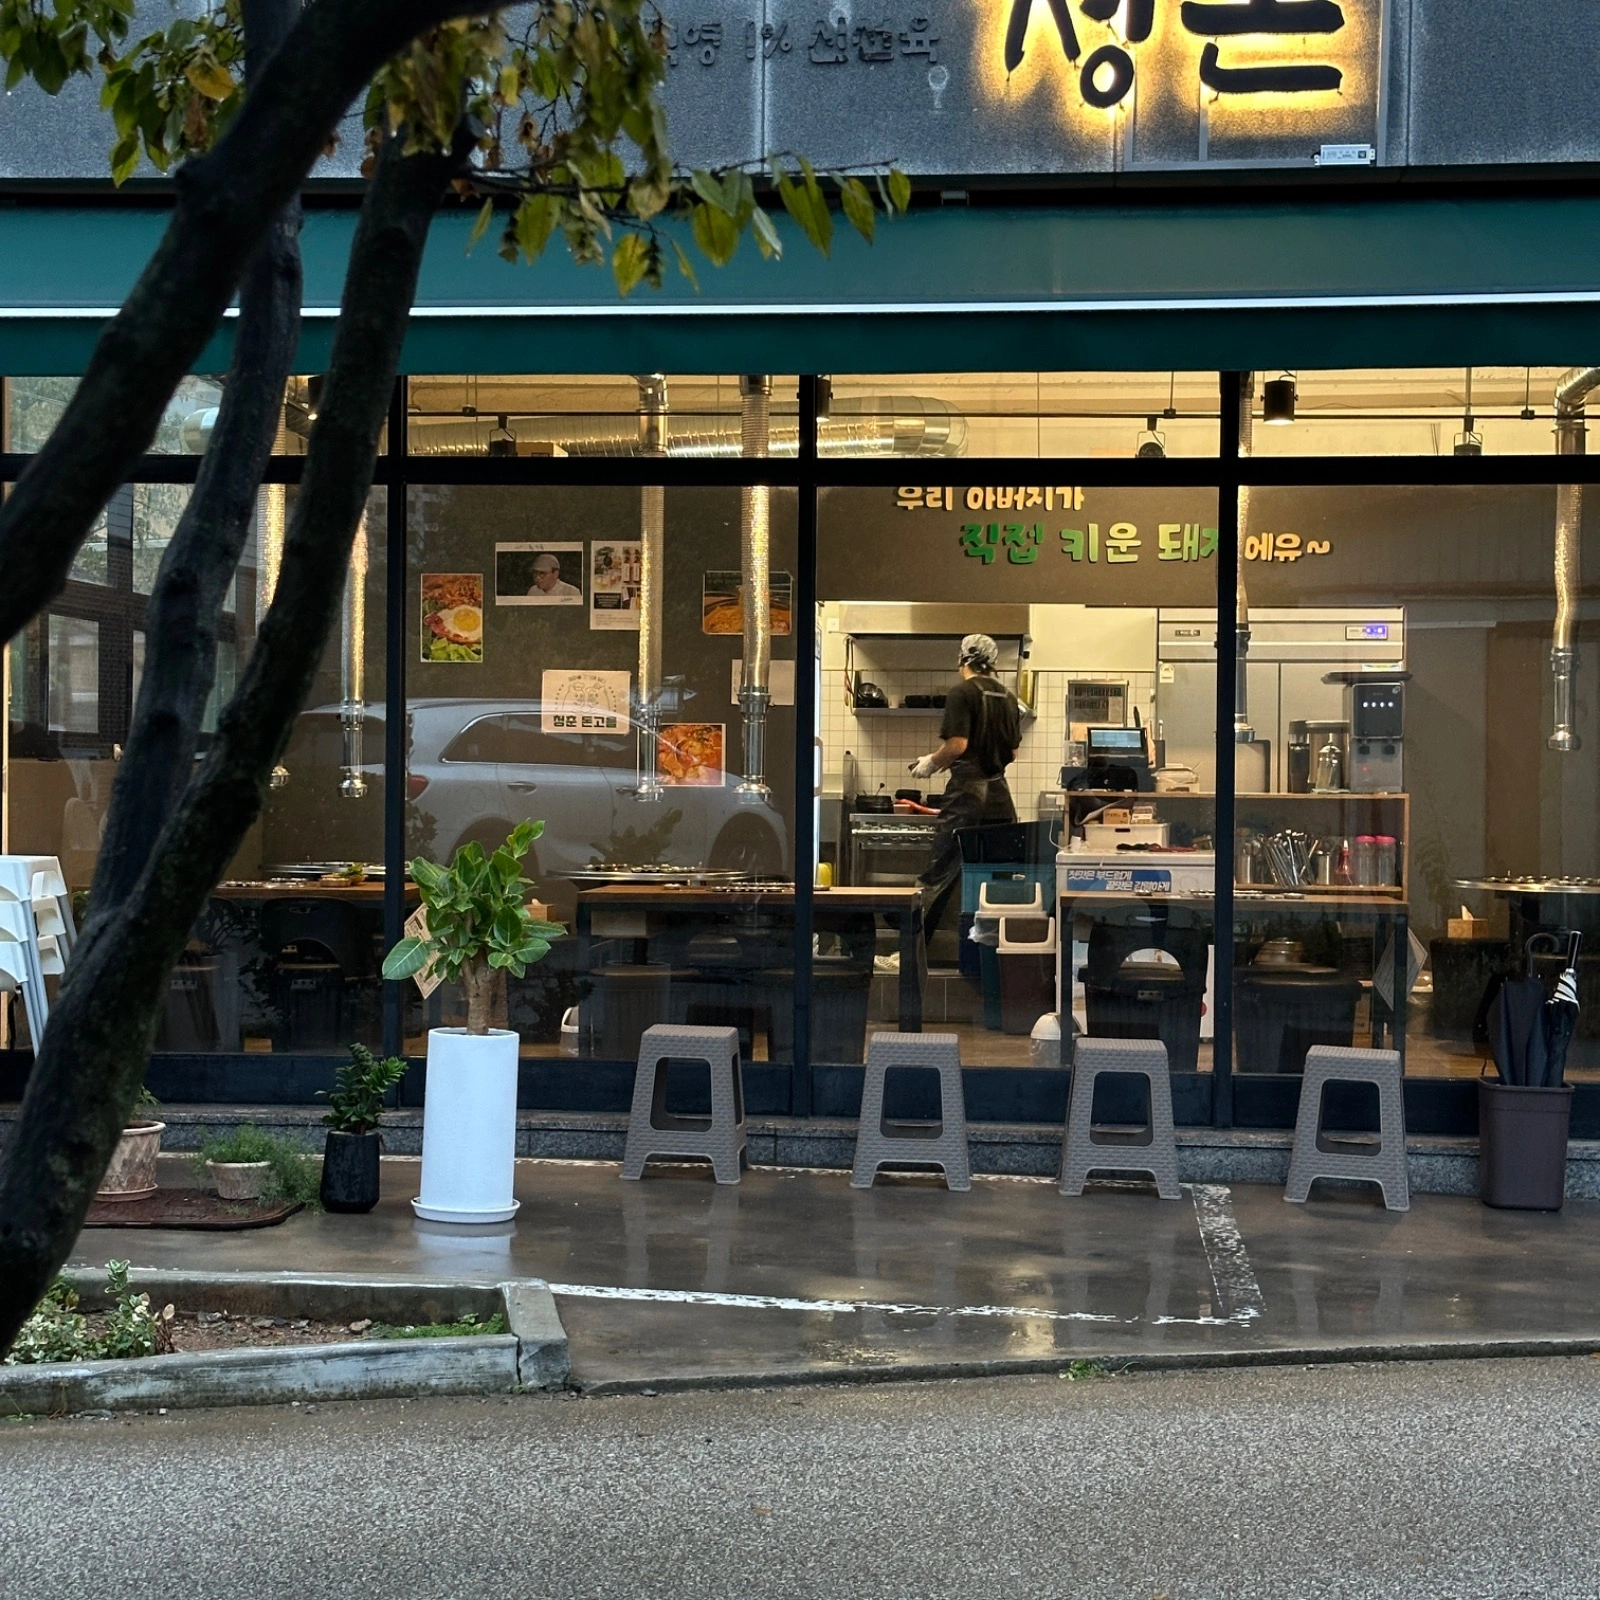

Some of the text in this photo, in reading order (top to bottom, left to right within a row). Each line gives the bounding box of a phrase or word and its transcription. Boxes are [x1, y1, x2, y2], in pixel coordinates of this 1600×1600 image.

[894, 486, 1086, 511] 우리 아버지가
[960, 521, 1045, 565] 직접
[1060, 522, 1142, 564] 키운
[553, 714, 577, 728] 청춘
